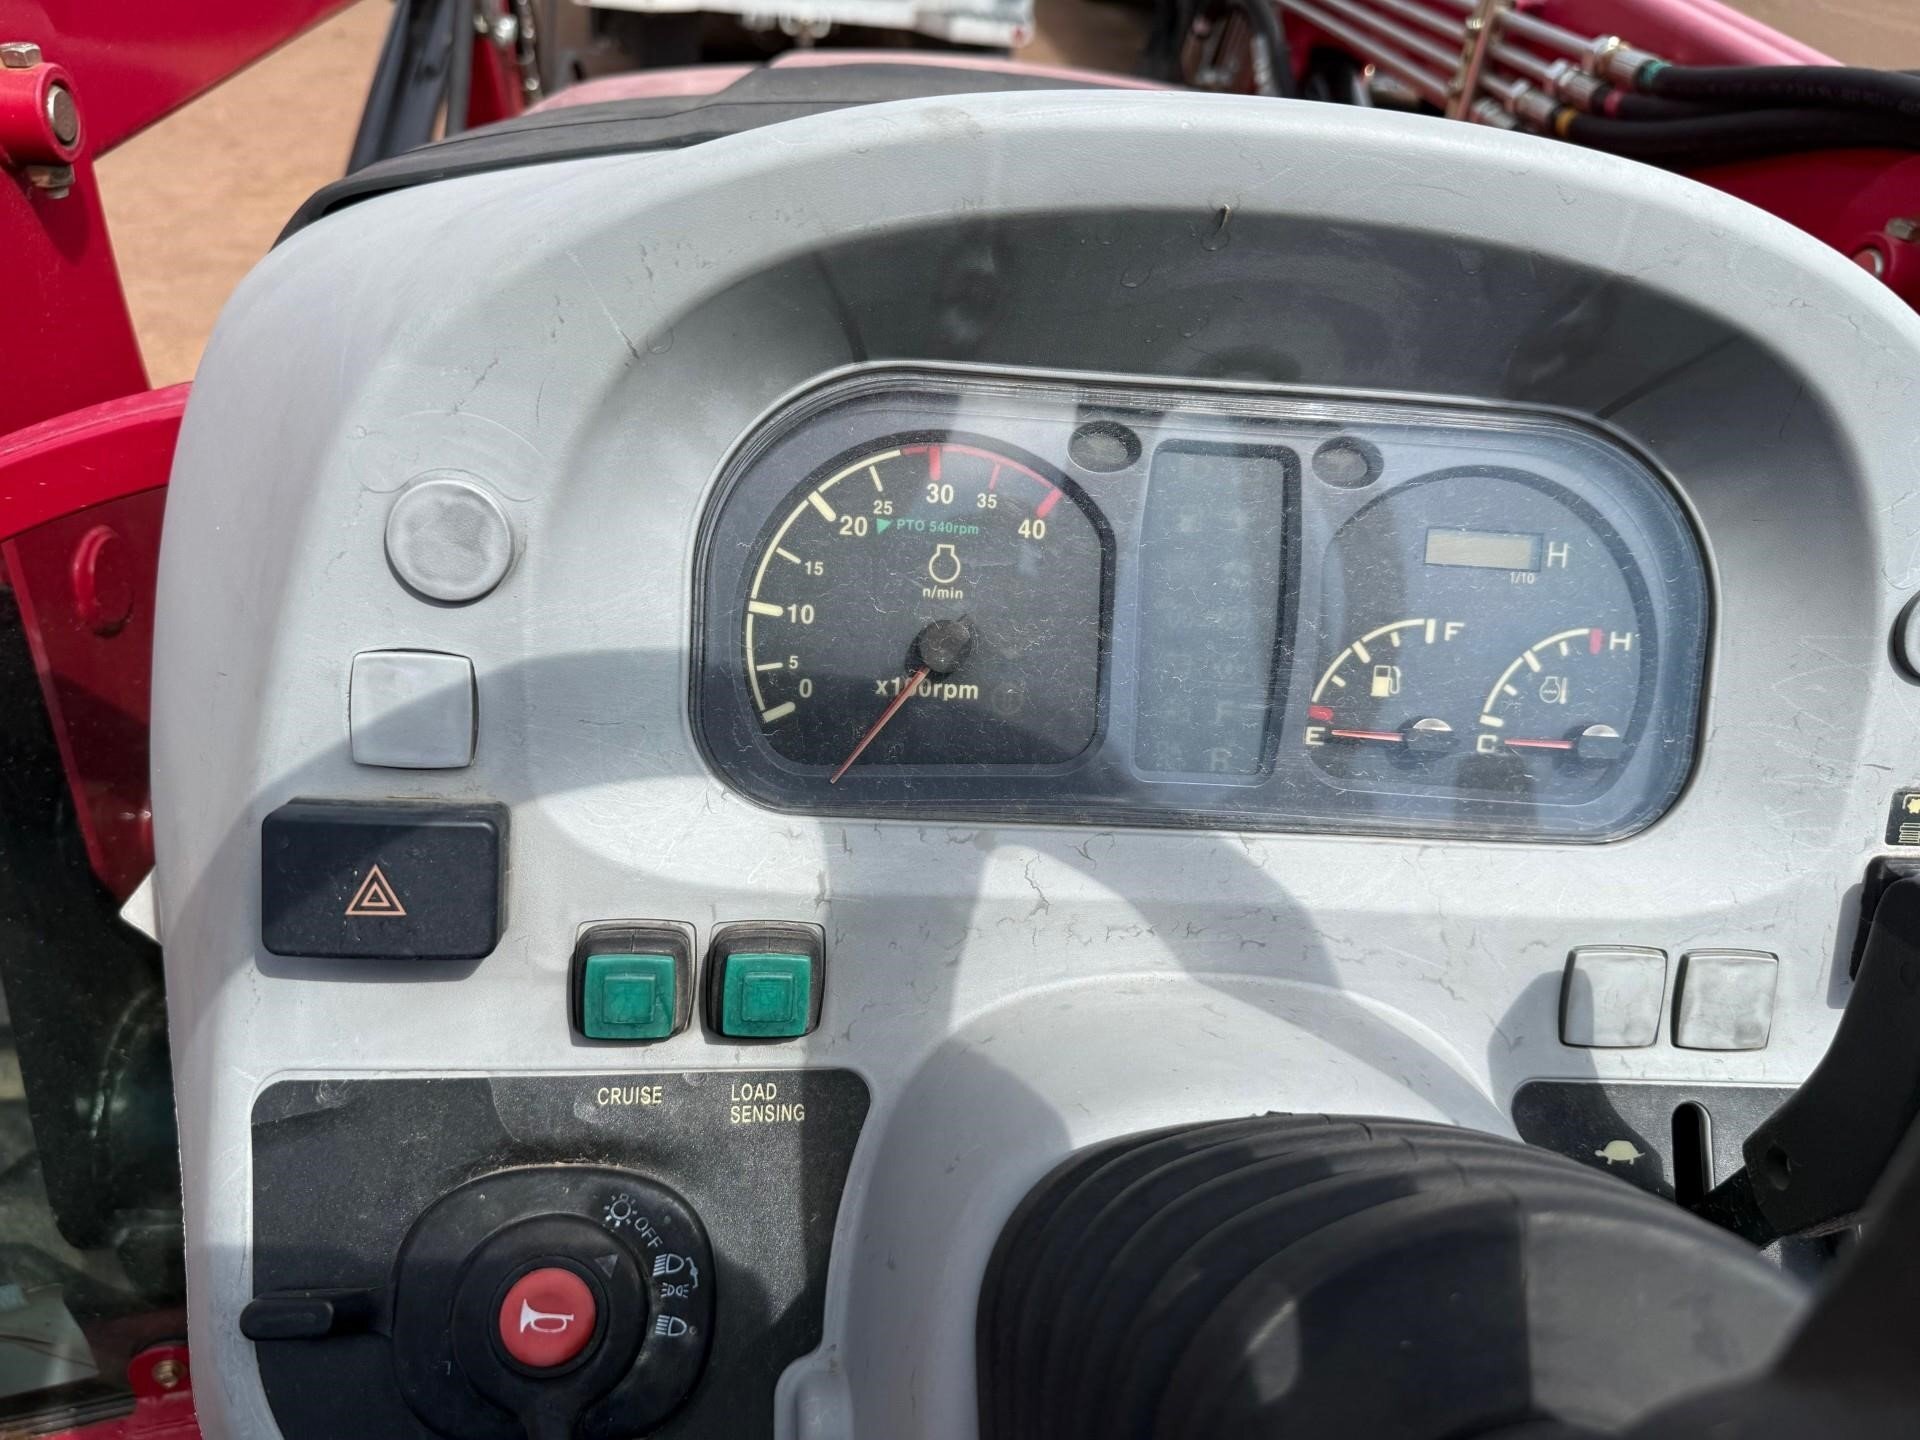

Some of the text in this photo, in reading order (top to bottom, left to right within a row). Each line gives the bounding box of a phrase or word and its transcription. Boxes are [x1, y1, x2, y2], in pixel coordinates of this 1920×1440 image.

[925, 484, 954, 504] 30
[976, 493, 997, 509] 35
[872, 501, 893, 516] 25
[839, 516, 868, 536] 20
[896, 519, 979, 535] PTO 540rpm
[1018, 519, 1046, 540] 40
[1547, 541, 1568, 568] H
[804, 562, 824, 576] 15
[1509, 572, 1536, 585] 1/10
[922, 585, 964, 600] n/min
[788, 604, 814, 625] 10
[1444, 622, 1465, 641] F
[1609, 631, 1632, 651] H
[788, 656, 798, 669] 5
[800, 679, 813, 698] 0
[1305, 727, 1326, 746] E
[1476, 734, 1499, 753] C
[598, 1086, 663, 1105] CRUISE
[731, 1083, 777, 1101] LOAD
[730, 1104, 806, 1124] SENSING
[634, 1216, 663, 1248] OFF
